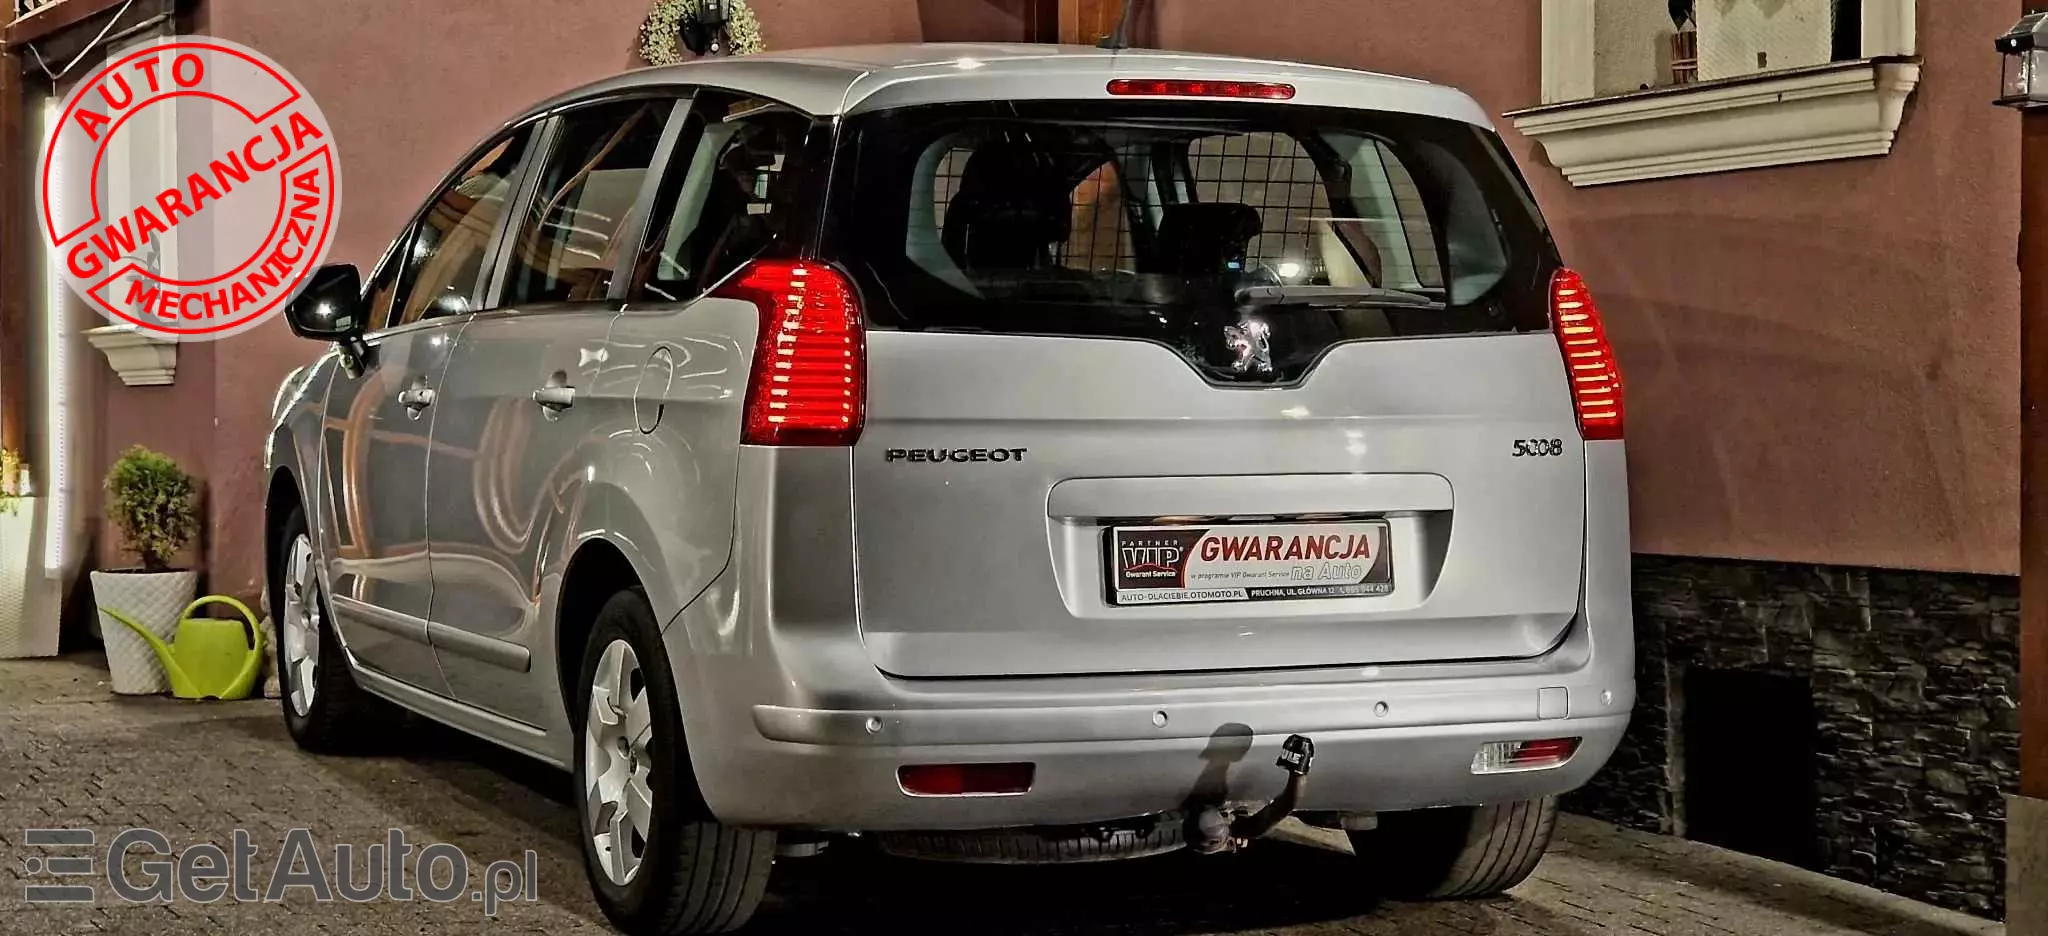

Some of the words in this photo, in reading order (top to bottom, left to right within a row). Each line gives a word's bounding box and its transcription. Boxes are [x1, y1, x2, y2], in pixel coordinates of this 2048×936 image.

[886, 448, 1028, 463] PEUGEOT
[1512, 438, 1563, 457] 5008
[1122, 546, 1179, 568] VIP
[1201, 535, 1370, 561] GWARANCJA
[1290, 565, 1315, 581] na
[1318, 562, 1362, 580] Auto
